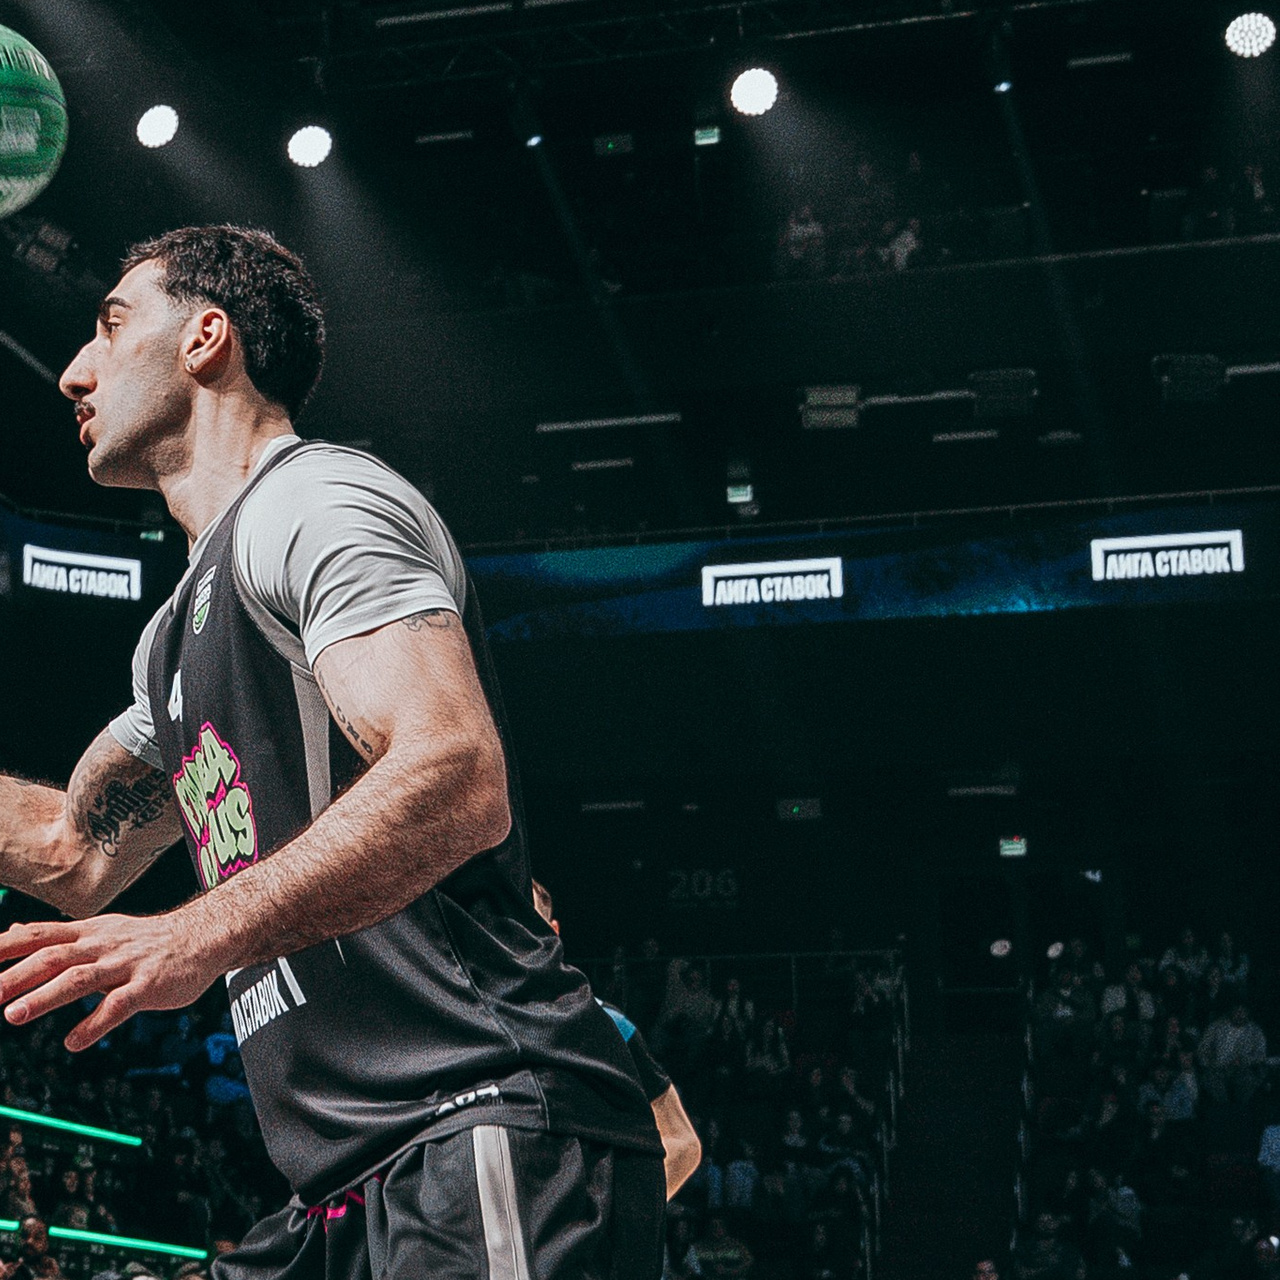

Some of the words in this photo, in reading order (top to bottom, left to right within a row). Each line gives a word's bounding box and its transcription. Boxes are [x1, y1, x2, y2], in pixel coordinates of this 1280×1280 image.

[1106, 553, 1154, 580] ЛИГА
[1155, 547, 1231, 577] СТАВОК
[69, 568, 130, 599] СТАВОК
[761, 574, 830, 602] СТАВОК
[242, 969, 289, 1040] СТАВОК
